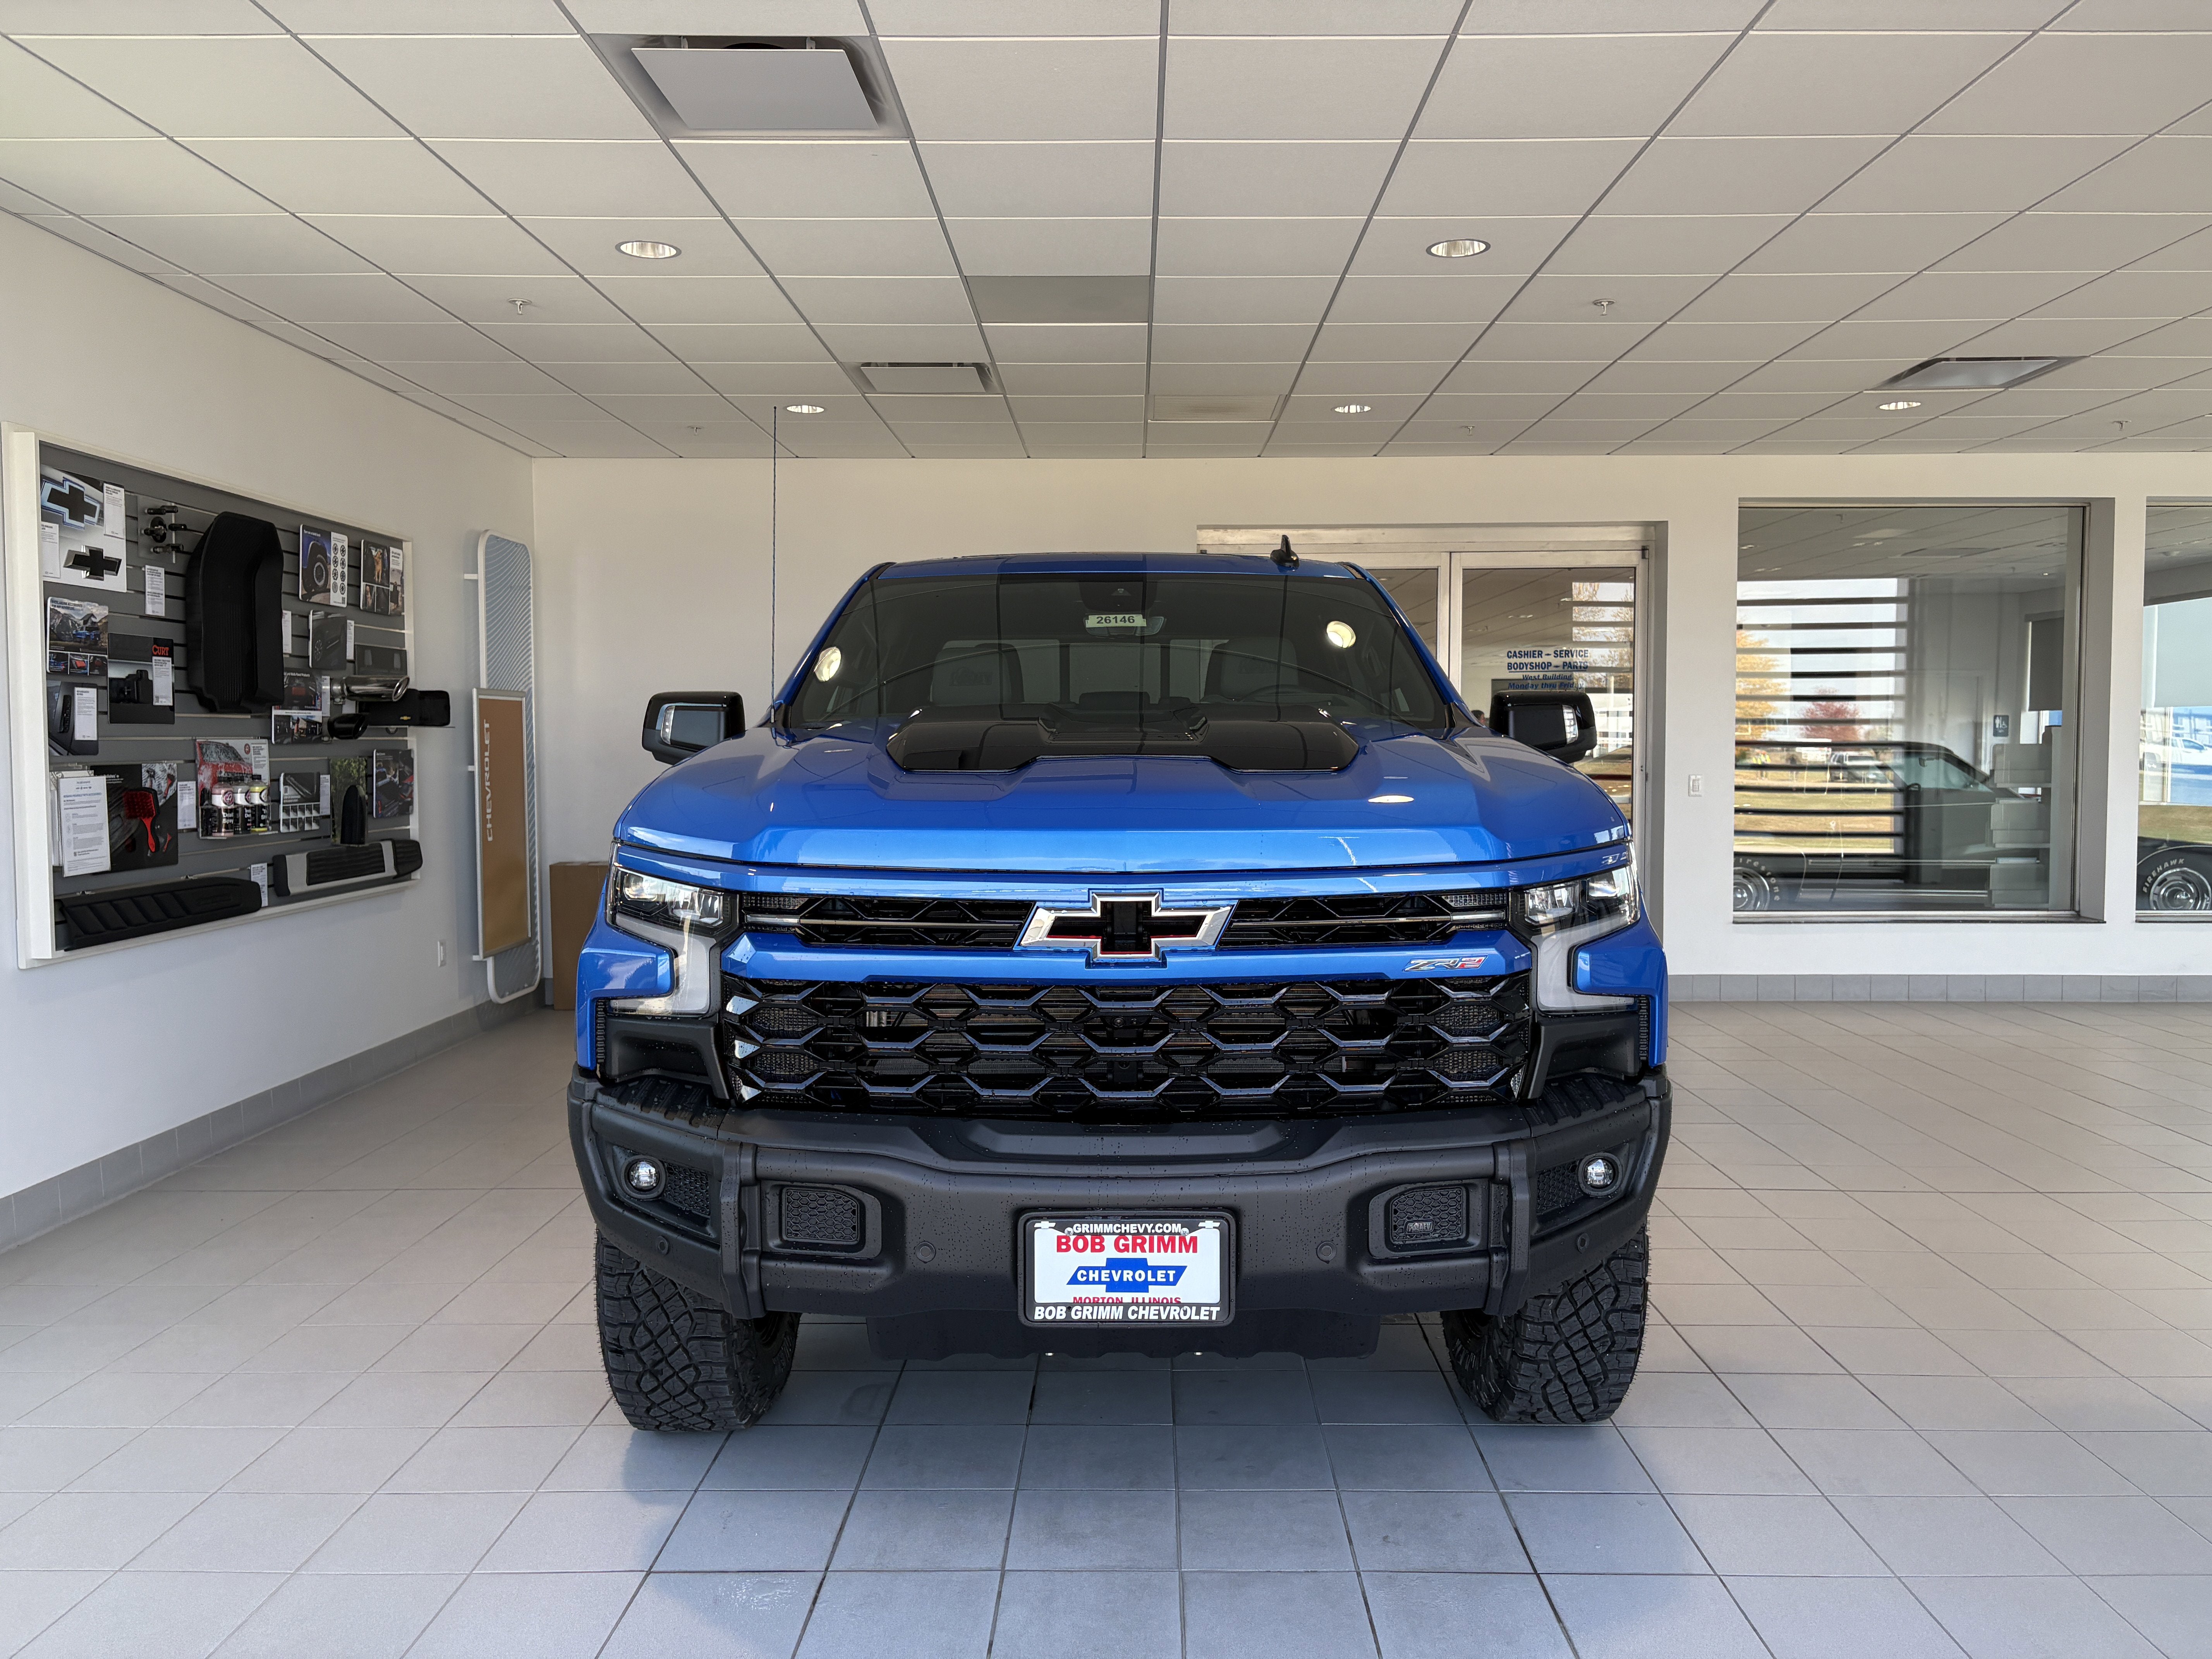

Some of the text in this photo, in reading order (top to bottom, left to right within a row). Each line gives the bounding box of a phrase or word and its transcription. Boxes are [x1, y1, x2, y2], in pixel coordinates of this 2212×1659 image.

[1096, 616, 1135, 624] 26146
[152, 645, 169, 656] CURT
[1506, 650, 1543, 659] CASHIER
[1553, 649, 1589, 658] SERVICE
[1507, 661, 1552, 670] BODYSHOP
[1562, 661, 1589, 670] PARTS
[484, 719, 493, 842] CHEVROLET
[1734, 858, 1780, 901] irestone
[2142, 858, 2185, 893] FIREHAWK
[1402, 955, 1488, 972] ZR2
[1072, 1223, 1182, 1234] GRIMMCHEVY.COM
[1056, 1235, 1198, 1253] BOB GRIMM
[1077, 1269, 1176, 1282] CHEVROLET
[1034, 1305, 1221, 1320] BOB GRIMM CHEVROLET
